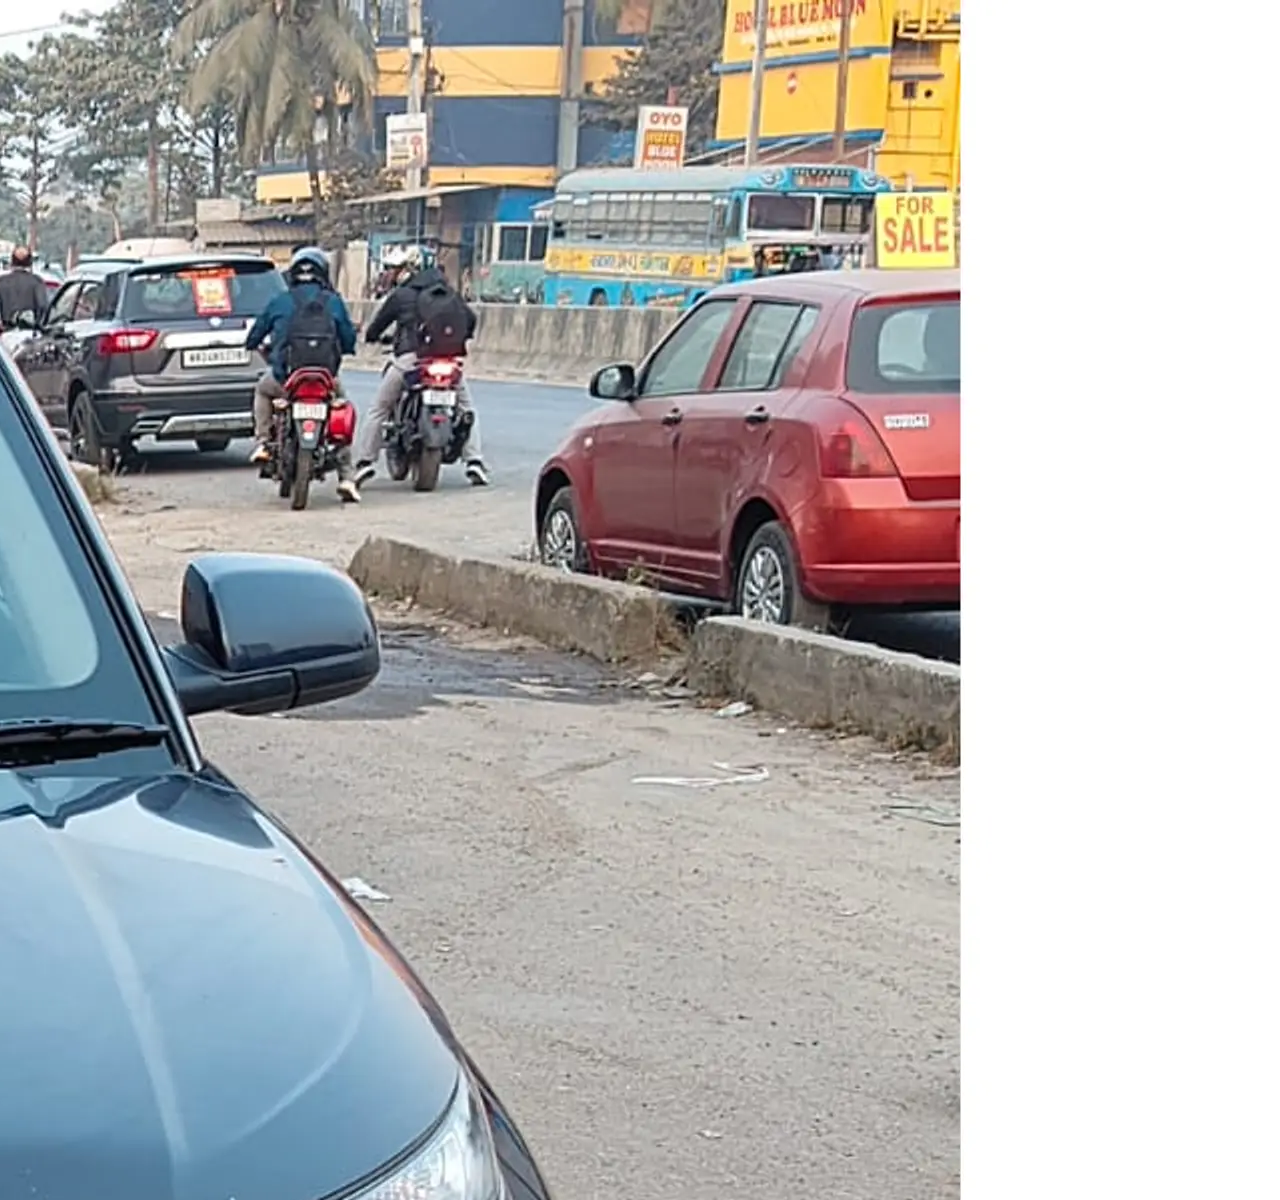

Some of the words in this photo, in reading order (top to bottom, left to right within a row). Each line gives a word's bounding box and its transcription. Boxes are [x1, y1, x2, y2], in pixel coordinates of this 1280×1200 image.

[734, 6, 777, 33] HOL
[650, 112, 681, 125] OYO
[896, 196, 934, 215] FOR
[884, 216, 949, 253] SALE
